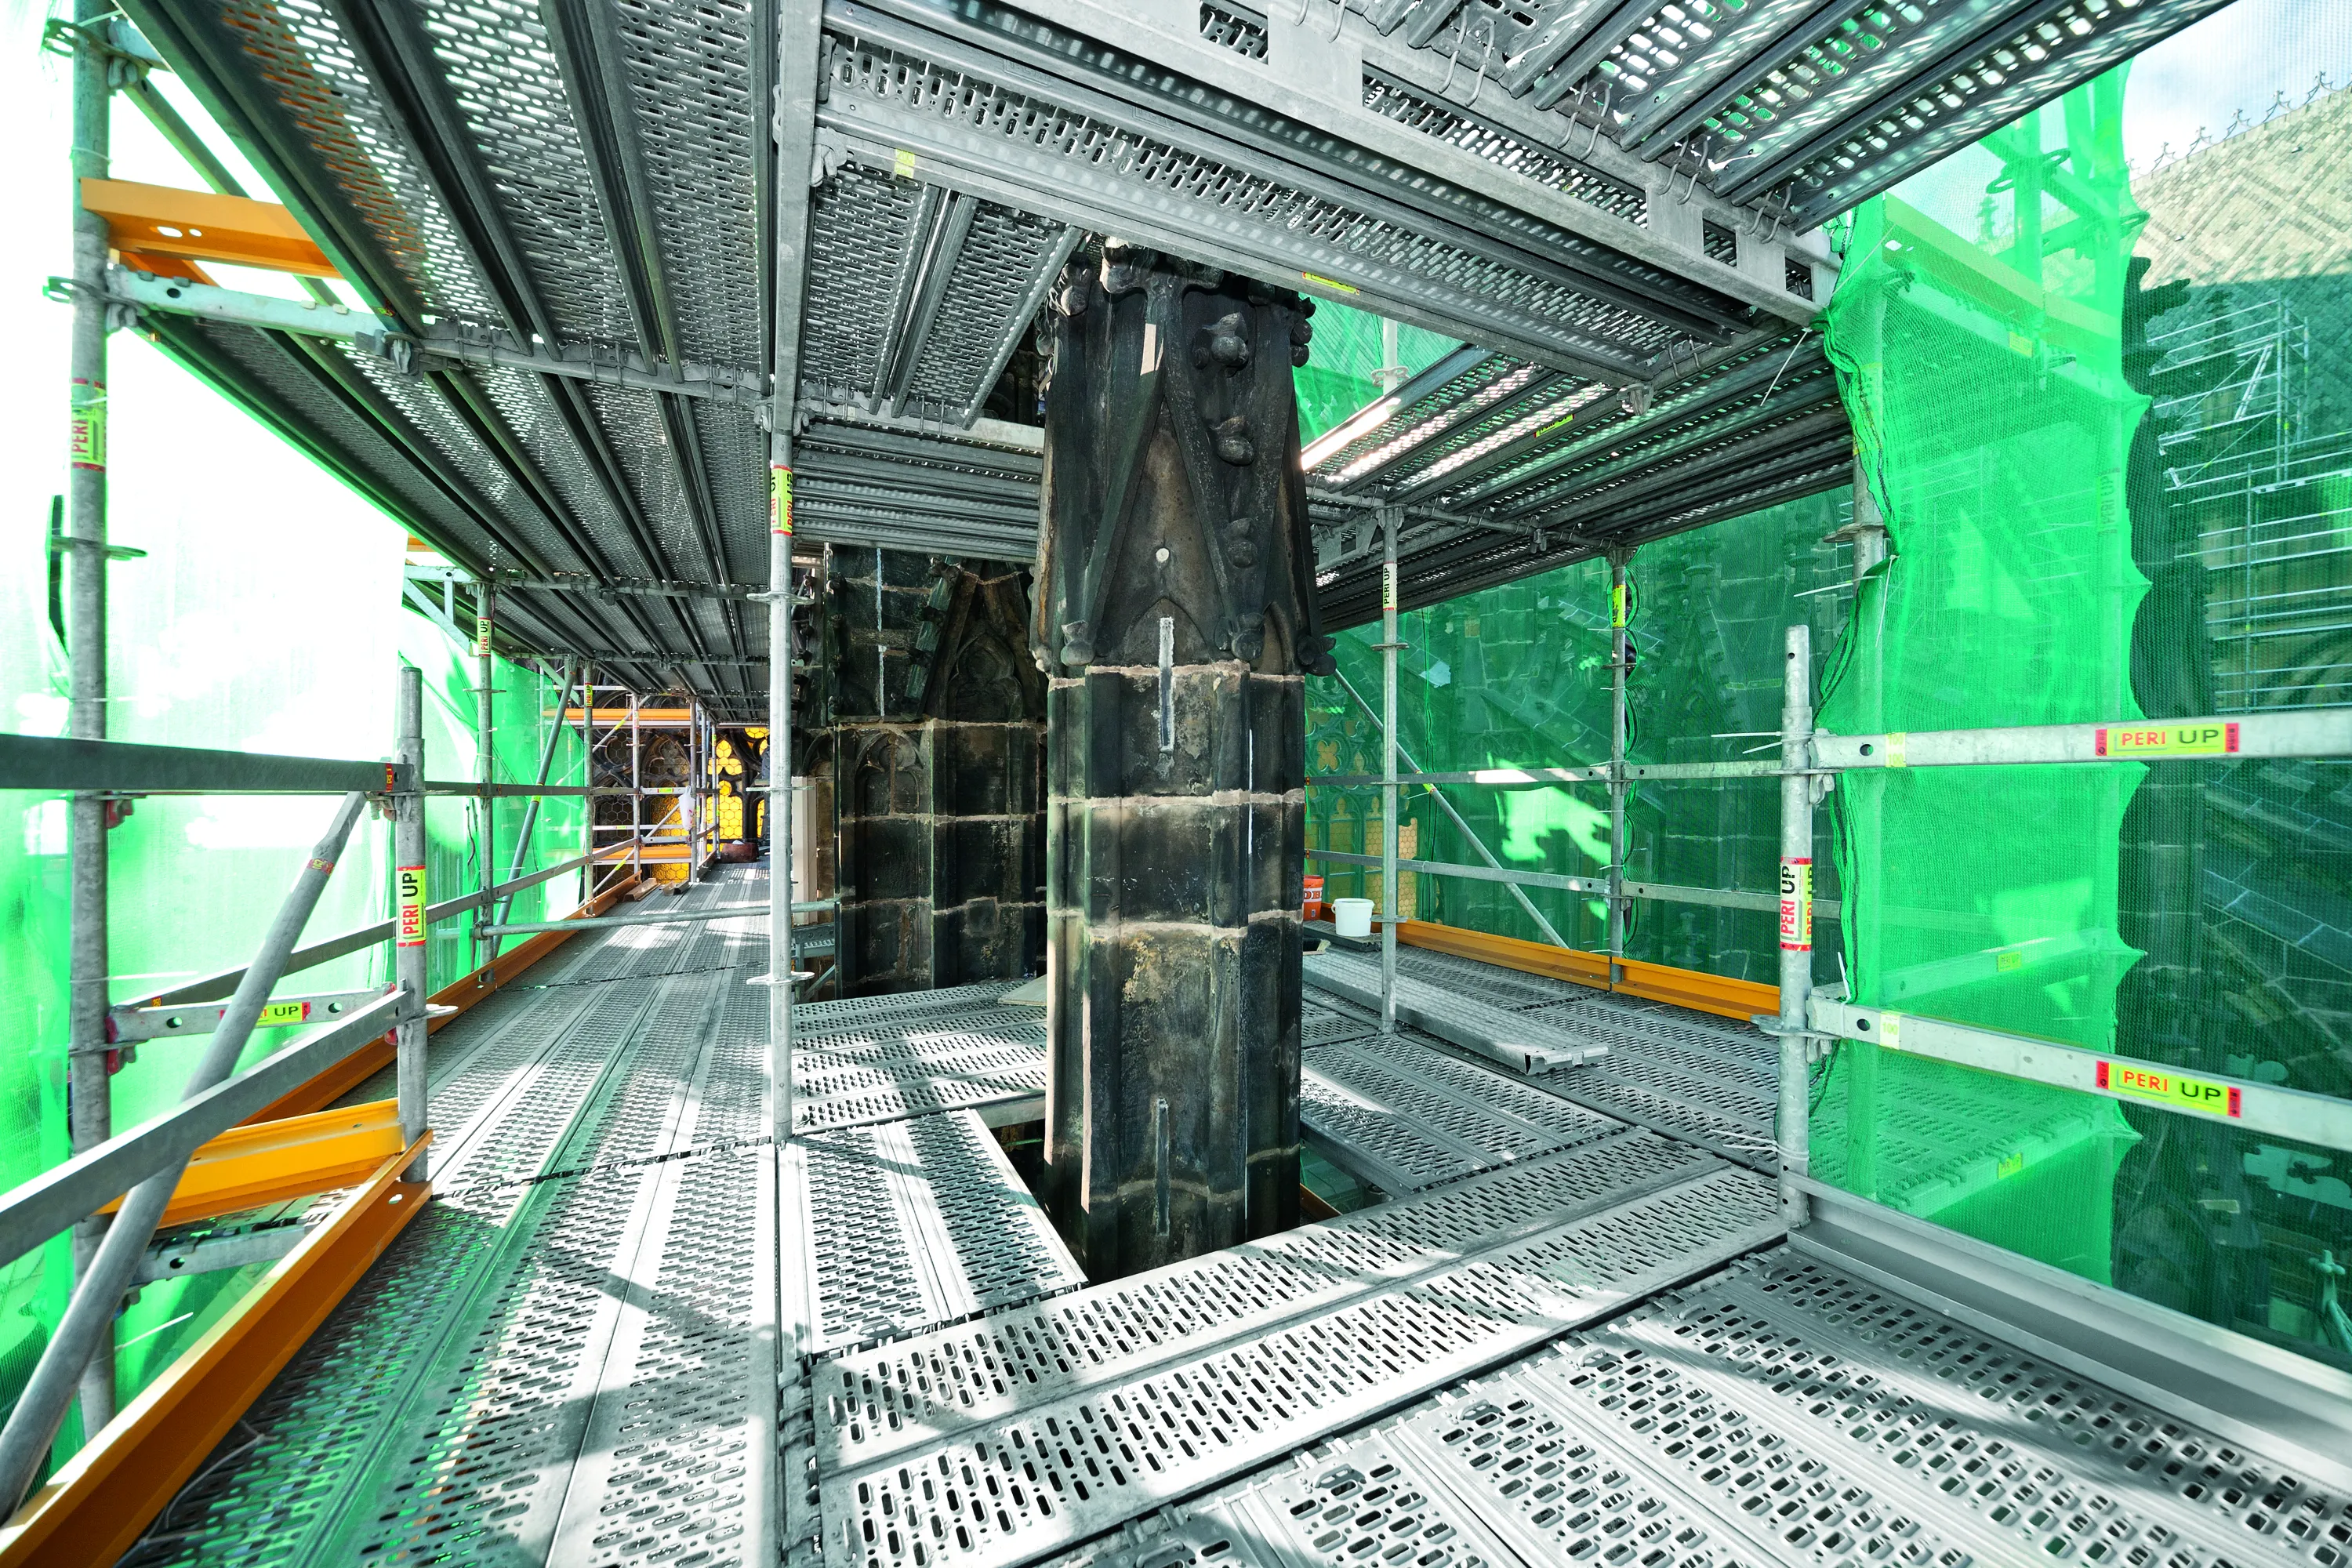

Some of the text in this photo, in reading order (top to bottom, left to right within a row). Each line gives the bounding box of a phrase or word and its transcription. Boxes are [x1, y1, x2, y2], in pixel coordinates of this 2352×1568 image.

[71, 419, 89, 453] PERI
[1384, 567, 1390, 581] UP
[480, 620, 488, 633] UP
[586, 684, 591, 693] UP
[2122, 731, 2166, 746] PERI
[2179, 729, 2219, 744] UP
[402, 873, 419, 935] PERI UP
[1780, 866, 1795, 935] PERI UP
[274, 1006, 299, 1017] UP
[1882, 1022, 1899, 1036] 100
[2123, 1070, 2168, 1092] PERI
[2181, 1082, 2221, 1101] UP
